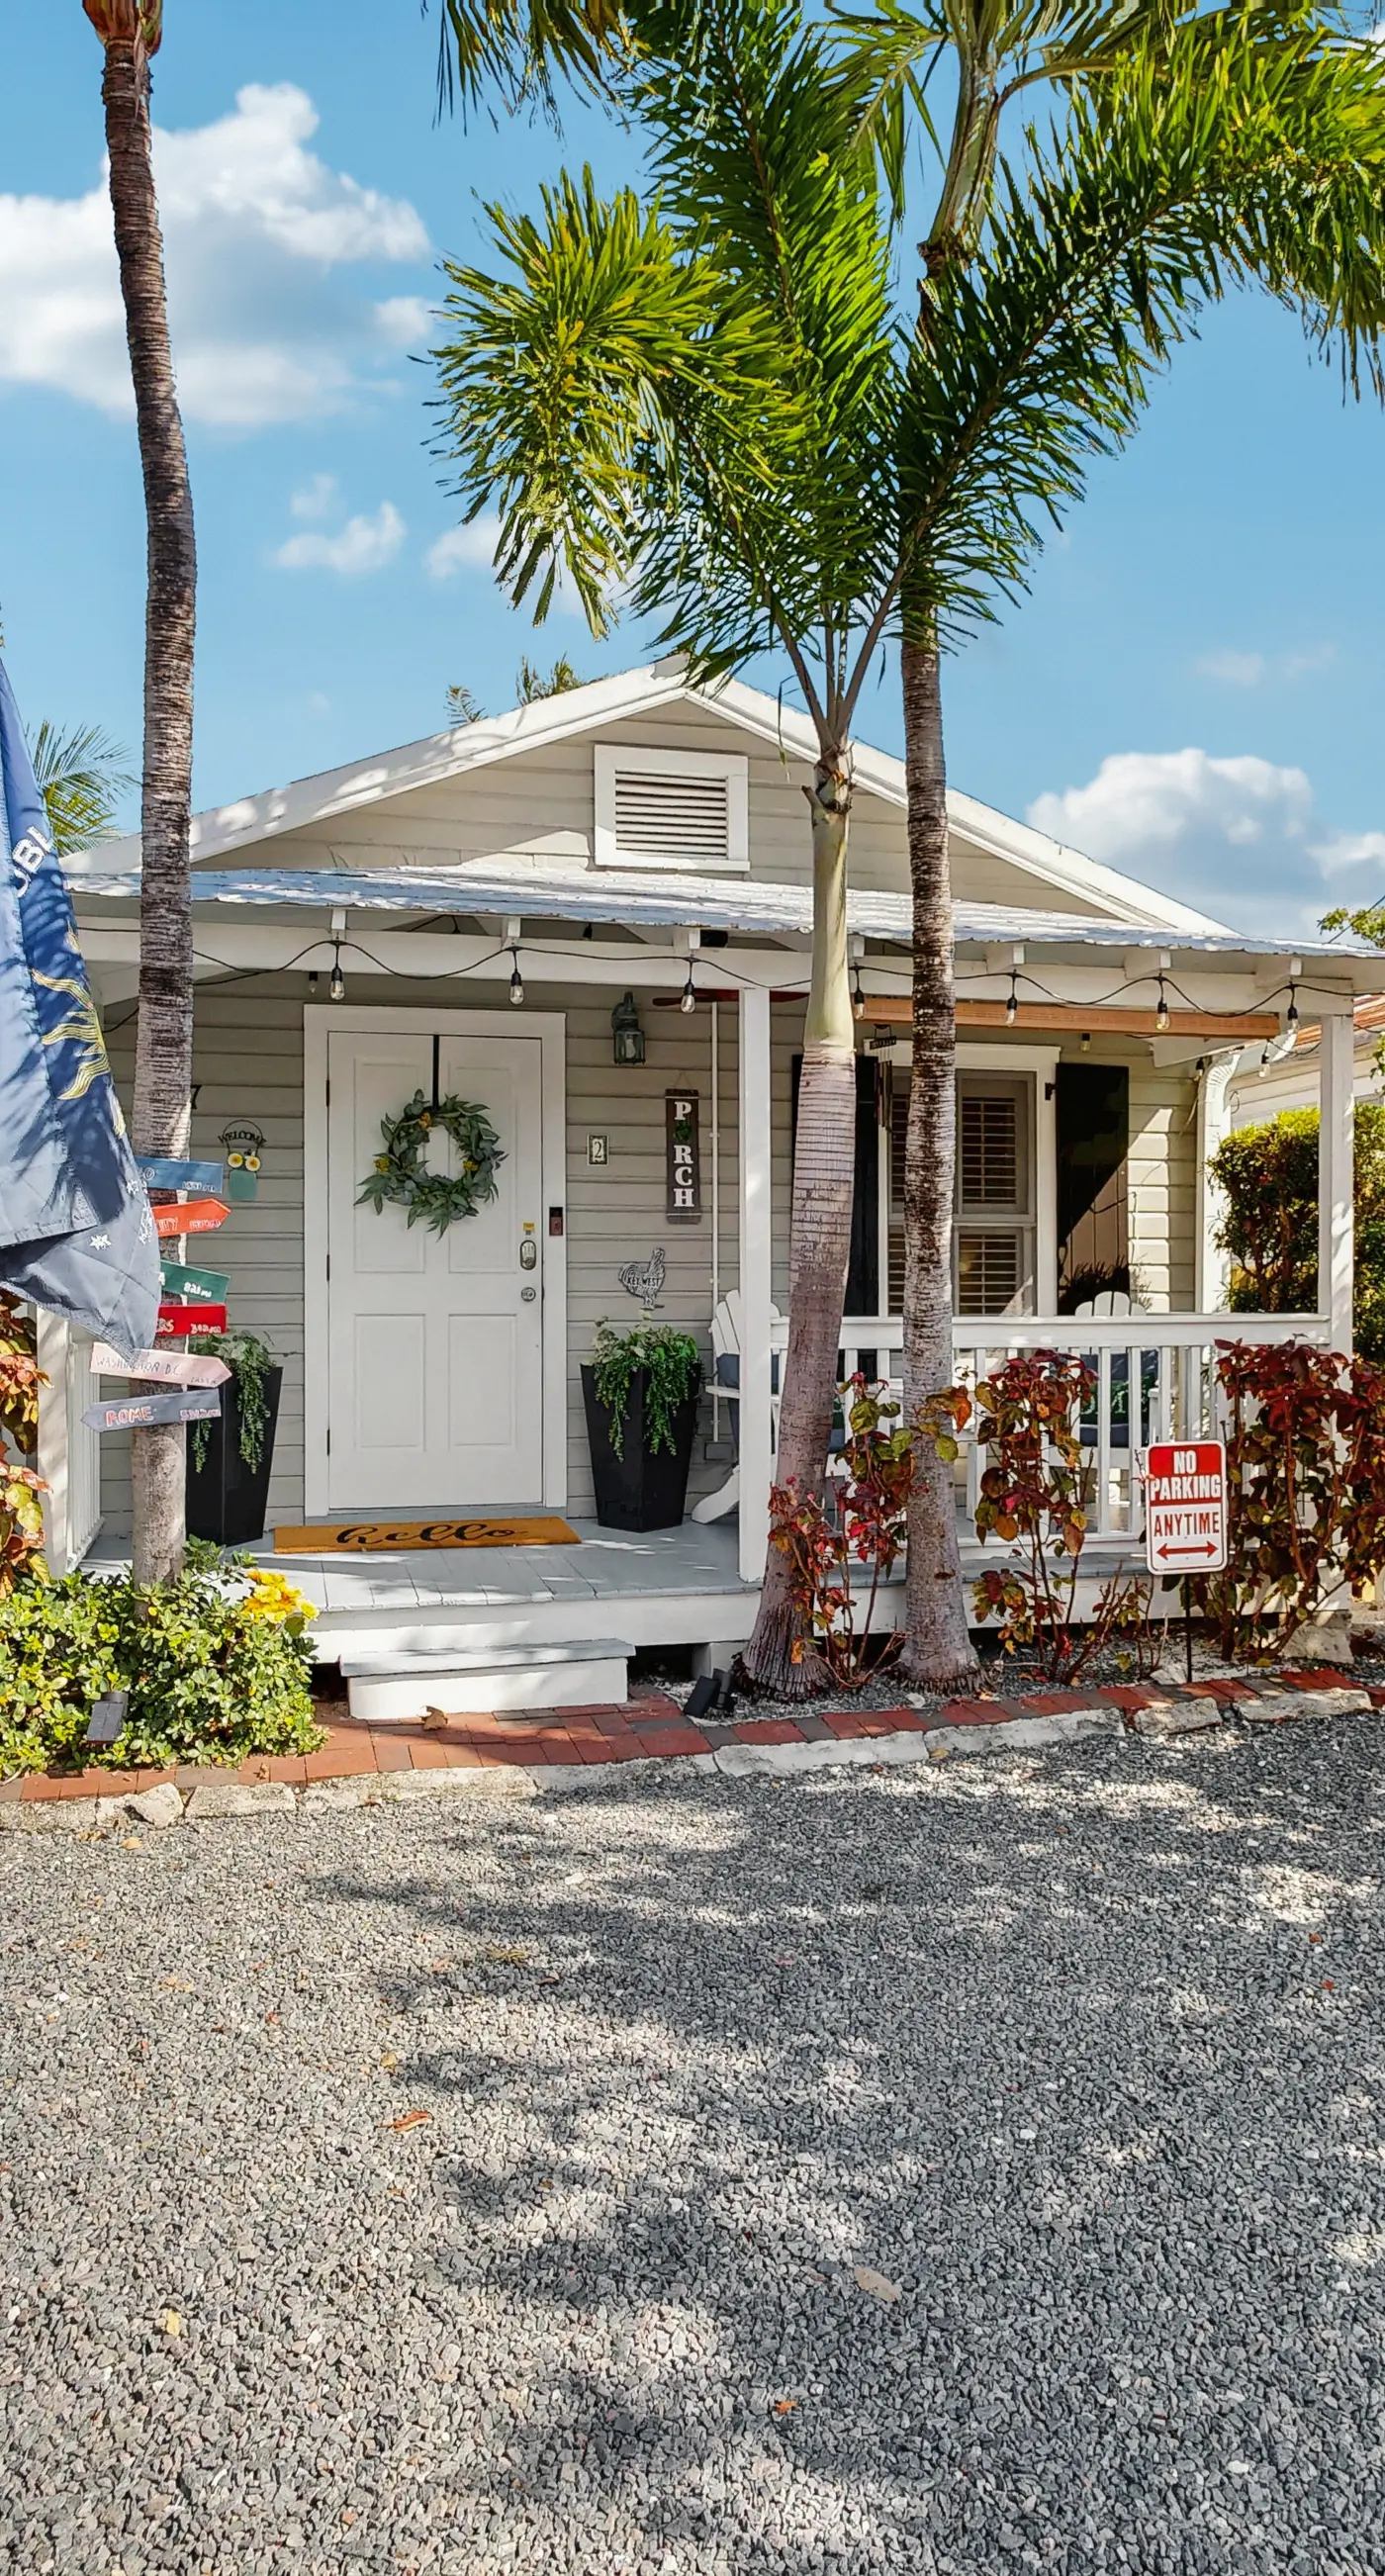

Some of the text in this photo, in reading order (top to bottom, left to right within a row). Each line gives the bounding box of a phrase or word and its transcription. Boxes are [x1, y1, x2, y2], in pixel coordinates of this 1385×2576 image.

[218, 1130, 267, 1148] WELCOME
[594, 1141, 602, 1158] 2
[627, 1276, 661, 1287] KEY WEST
[105, 1406, 155, 1427] ROME
[1172, 1449, 1197, 1475] NO
[1150, 1474, 1222, 1501] PARKING
[335, 1522, 524, 1545] hello
[1154, 1512, 1220, 1537] ANYTIME
